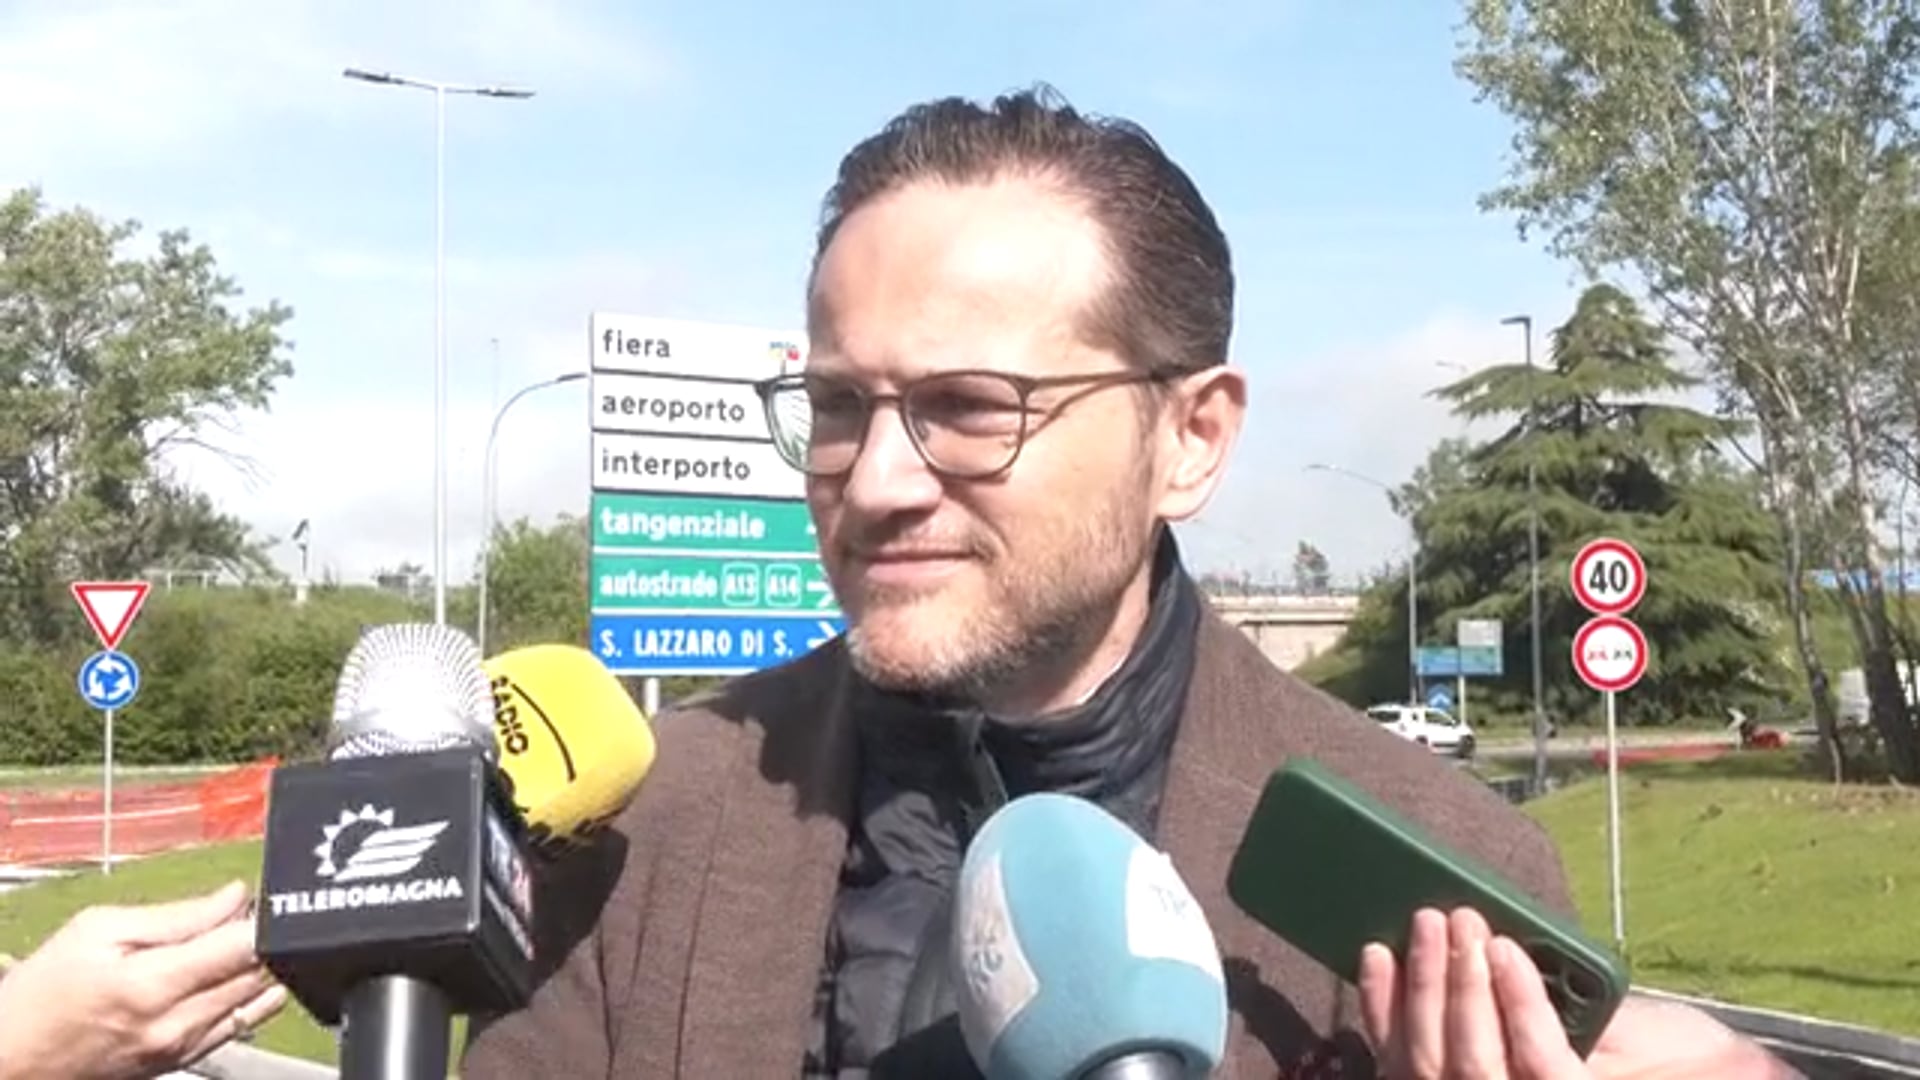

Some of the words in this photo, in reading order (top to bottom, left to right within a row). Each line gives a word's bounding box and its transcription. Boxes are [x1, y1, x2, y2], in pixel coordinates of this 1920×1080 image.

[602, 329, 670, 357] fiera
[602, 395, 745, 421] aeroporto
[602, 448, 751, 480] interporto
[601, 507, 765, 540] tangenziale
[601, 569, 717, 596] autostrade
[768, 575, 798, 597] A14
[1589, 560, 1628, 594] 40
[601, 629, 622, 657] S.
[634, 630, 732, 657] LAZZARO
[741, 632, 764, 656] DI
[773, 633, 793, 657] S.
[270, 877, 463, 917] TELEROMAGNA
